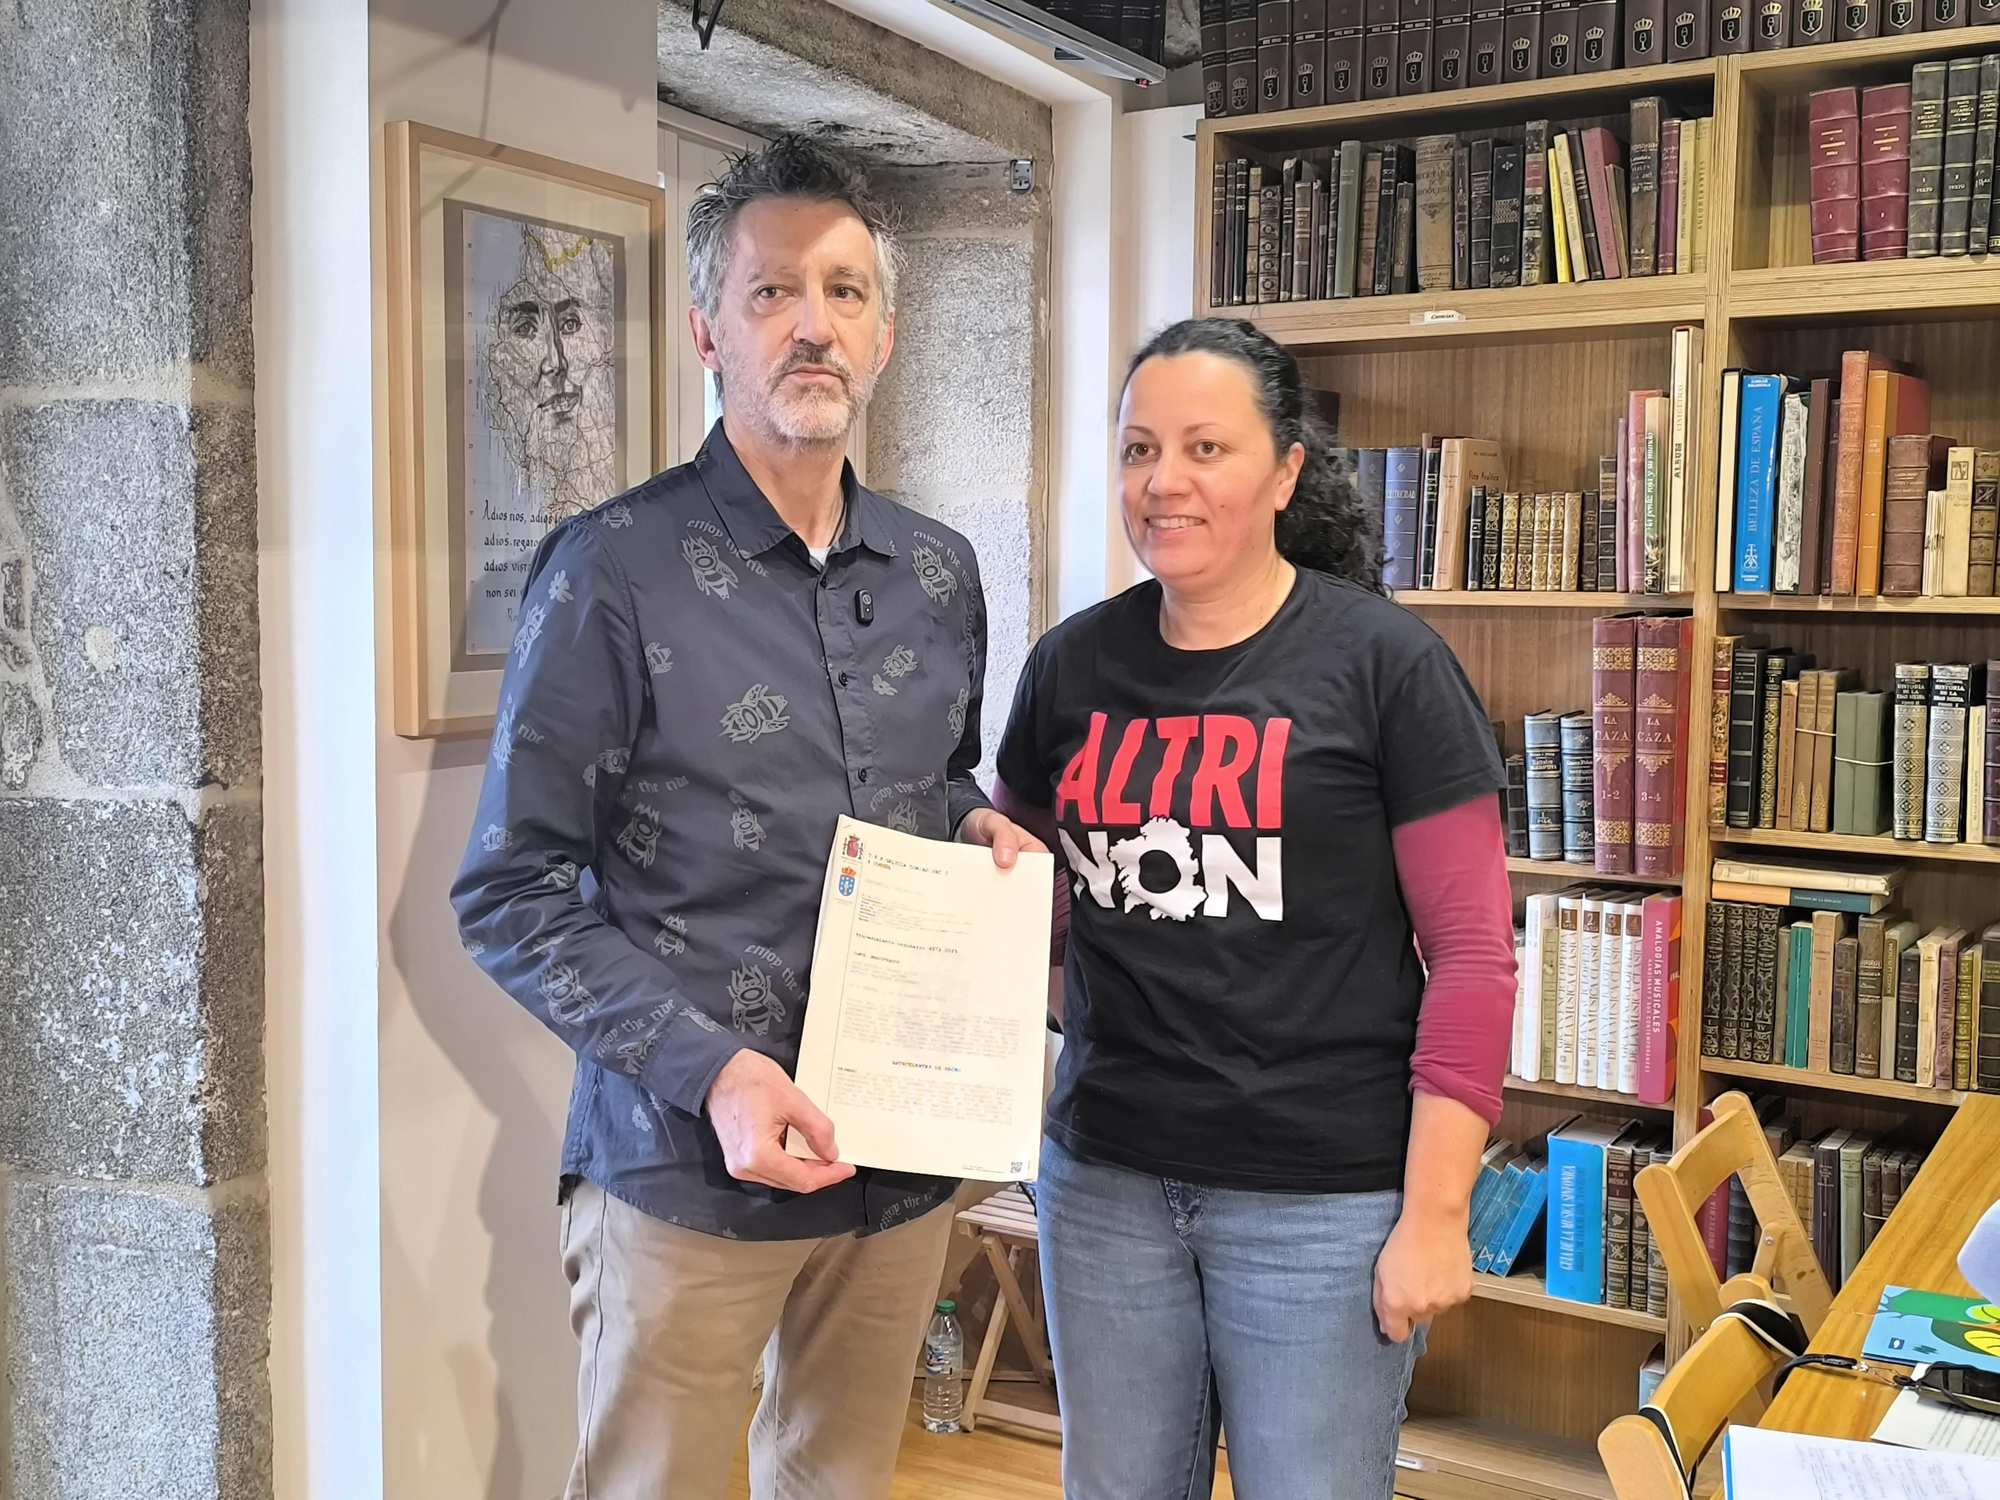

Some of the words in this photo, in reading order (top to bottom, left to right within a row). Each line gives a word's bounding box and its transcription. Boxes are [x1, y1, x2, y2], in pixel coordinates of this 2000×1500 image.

[1752, 405, 1763, 454] ESPAÑA
[1648, 459, 1653, 469] su
[1750, 458, 1760, 475] DE
[1646, 478, 1655, 492] roja
[1748, 482, 1759, 532] BELLEZA
[687, 519, 723, 539] enjoy
[746, 559, 770, 578] ride
[913, 530, 943, 549] enjoy
[946, 546, 961, 568] the
[486, 589, 502, 598] non
[504, 588, 516, 598] sei
[1604, 716, 1618, 724] LA
[1647, 718, 1660, 726] LA
[517, 723, 545, 744] ride
[1595, 731, 1630, 741] CAZA
[1637, 732, 1672, 743] CAZA
[1056, 712, 1292, 829] ALTRI
[638, 780, 659, 793] the
[870, 787, 892, 812] enjoy
[894, 781, 915, 794] the
[1601, 790, 1620, 800] 1-2
[1641, 791, 1662, 802] 3-4
[1058, 815, 1283, 922] NON
[1564, 909, 1571, 922] 1
[1587, 912, 1594, 925] 2
[1608, 915, 1616, 928] 3
[1567, 932, 1577, 976] CLASICA
[1590, 935, 1600, 979] CLASICA
[1611, 937, 1621, 982] CLASICA
[1653, 920, 1663, 974] ANALOGÍAS
[744, 944, 783, 969] enjoy
[781, 967, 798, 992] the
[1558, 934, 1568, 1014] ENCICLOPEDIA
[1633, 939, 1643, 985] CLASICA
[1581, 936, 1590, 1018] ENCICLOPEDIA
[1601, 939, 1612, 1021] ENCICLOPEDIA
[1566, 980, 1575, 1020] MUSICA
[1589, 983, 1598, 1022] MUSICA
[1609, 985, 1619, 1025] MUSICA
[1630, 988, 1640, 1030] MUSICA
[1652, 976, 1662, 1034] MUSICALES
[596, 1028, 619, 1058] enjoy
[621, 1016, 646, 1033] the
[650, 999, 676, 1022] ride
[1556, 1017, 1564, 1048] GRAN
[1565, 1023, 1574, 1038] LA
[1588, 1026, 1596, 1042] LA
[1600, 1024, 1608, 1055] GRAN
[1608, 1029, 1617, 1044] LA
[1630, 1032, 1638, 1046] LA
[1564, 1040, 1573, 1054] DE
[1587, 1044, 1596, 1056] DE
[1608, 1048, 1616, 1060] DE
[1629, 1049, 1638, 1062] DE
[1561, 1166, 1576, 1202] SINFONICA
[903, 1196, 920, 1210] the
[1561, 1204, 1575, 1229] MUSICA
[1708, 1202, 1716, 1249] ENOTECNIA
[1560, 1231, 1574, 1240] LA
[1560, 1242, 1574, 1252] DE
